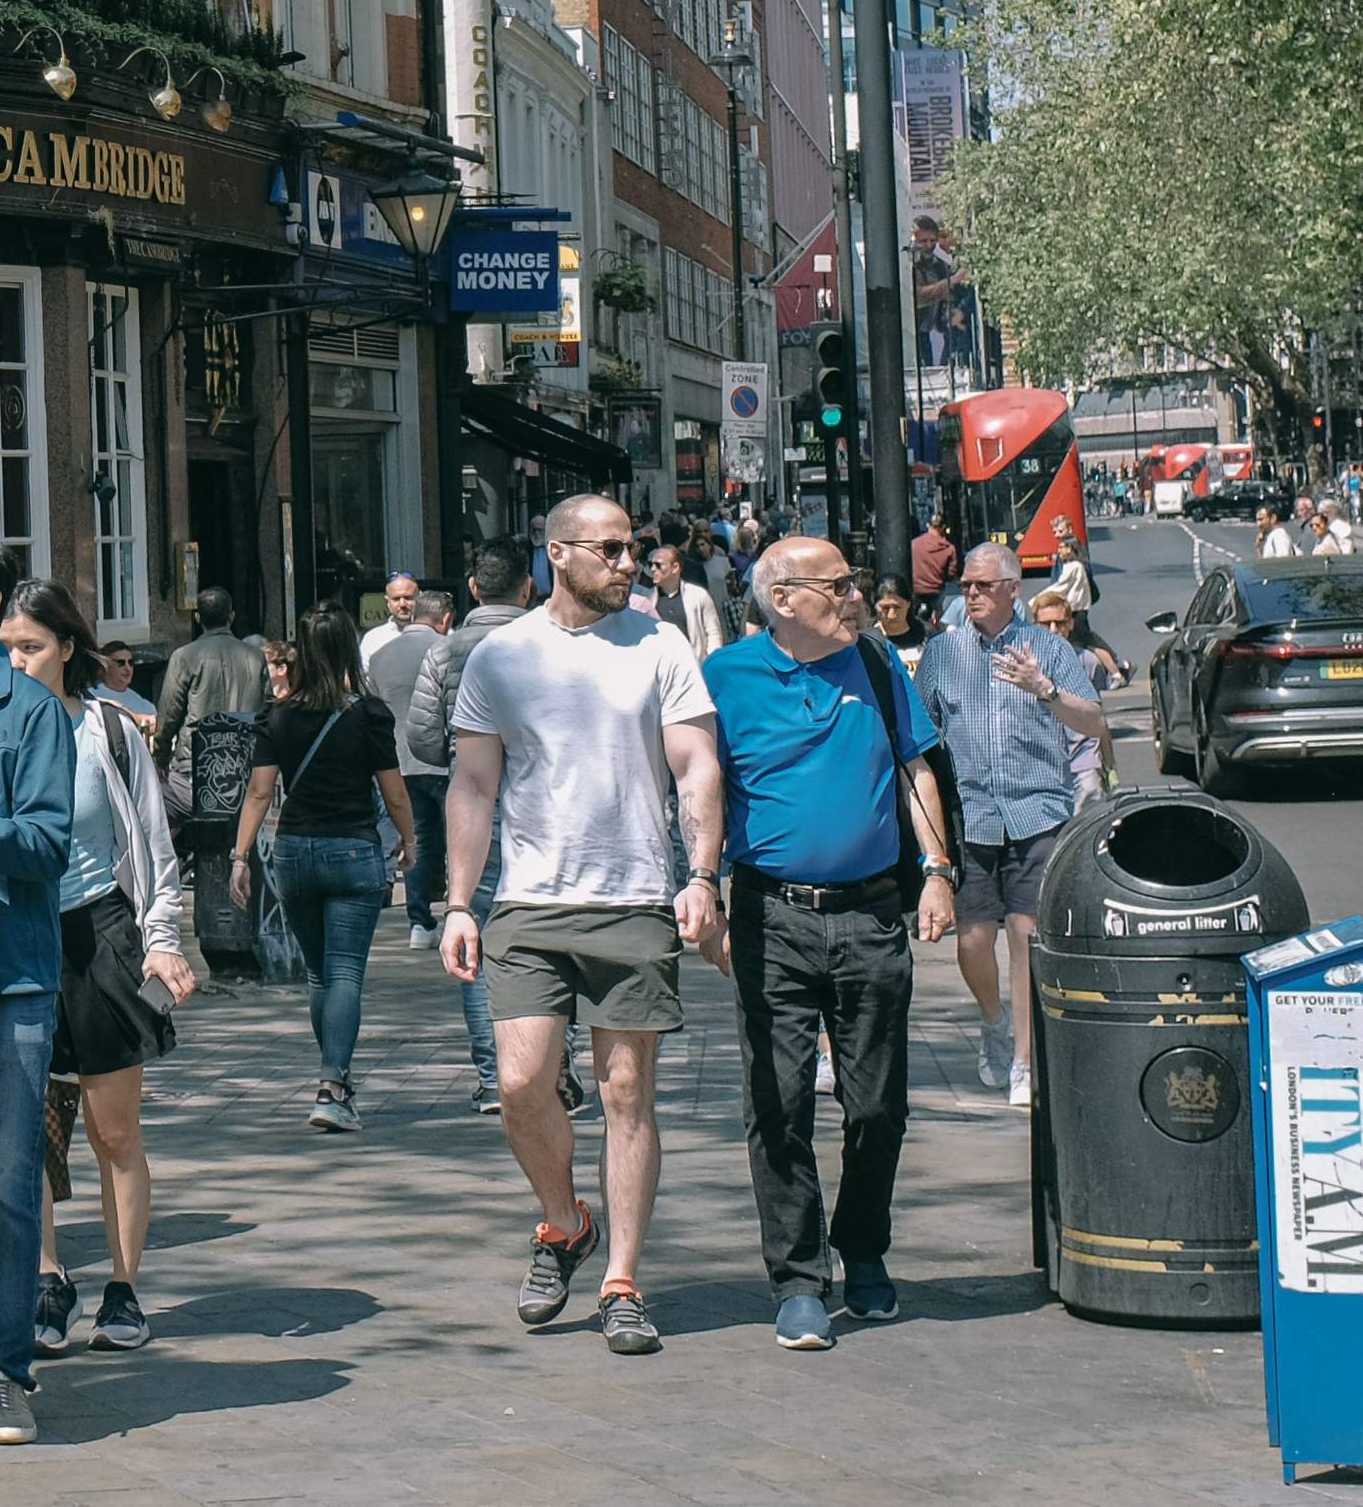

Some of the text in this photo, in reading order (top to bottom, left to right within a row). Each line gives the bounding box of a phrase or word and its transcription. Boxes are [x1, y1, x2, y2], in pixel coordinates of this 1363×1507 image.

[907, 101, 933, 183] MOUNTAIN
[458, 252, 550, 269] CHANGE
[457, 271, 550, 290] MONEY
[731, 373, 758, 383] ZONE
[1021, 458, 1040, 474] 38
[1137, 915, 1227, 935] general litter
[1275, 995, 1298, 1006] GET
[1301, 995, 1334, 1006] YOUR
[1287, 1066, 1303, 1241] LONDON'S BUSINESS NEWSPAPER
